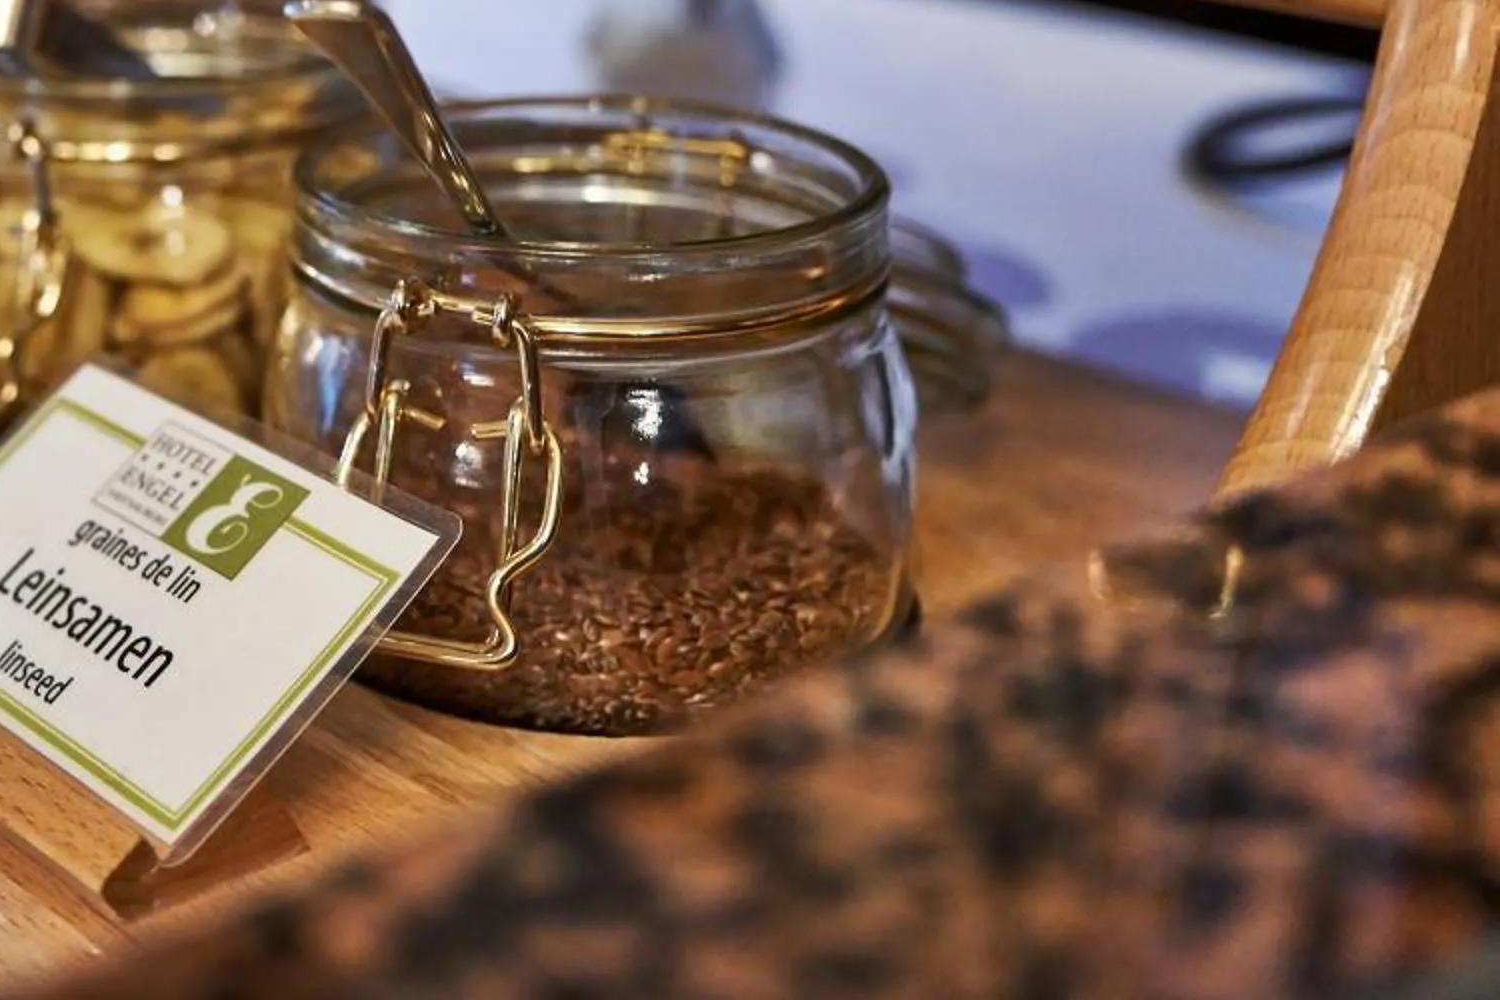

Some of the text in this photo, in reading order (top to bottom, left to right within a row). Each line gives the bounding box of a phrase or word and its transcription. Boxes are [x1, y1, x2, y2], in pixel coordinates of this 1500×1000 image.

[152, 432, 217, 477] HOTEL
[119, 466, 186, 510] ENGEL
[67, 519, 201, 604] graines de lin
